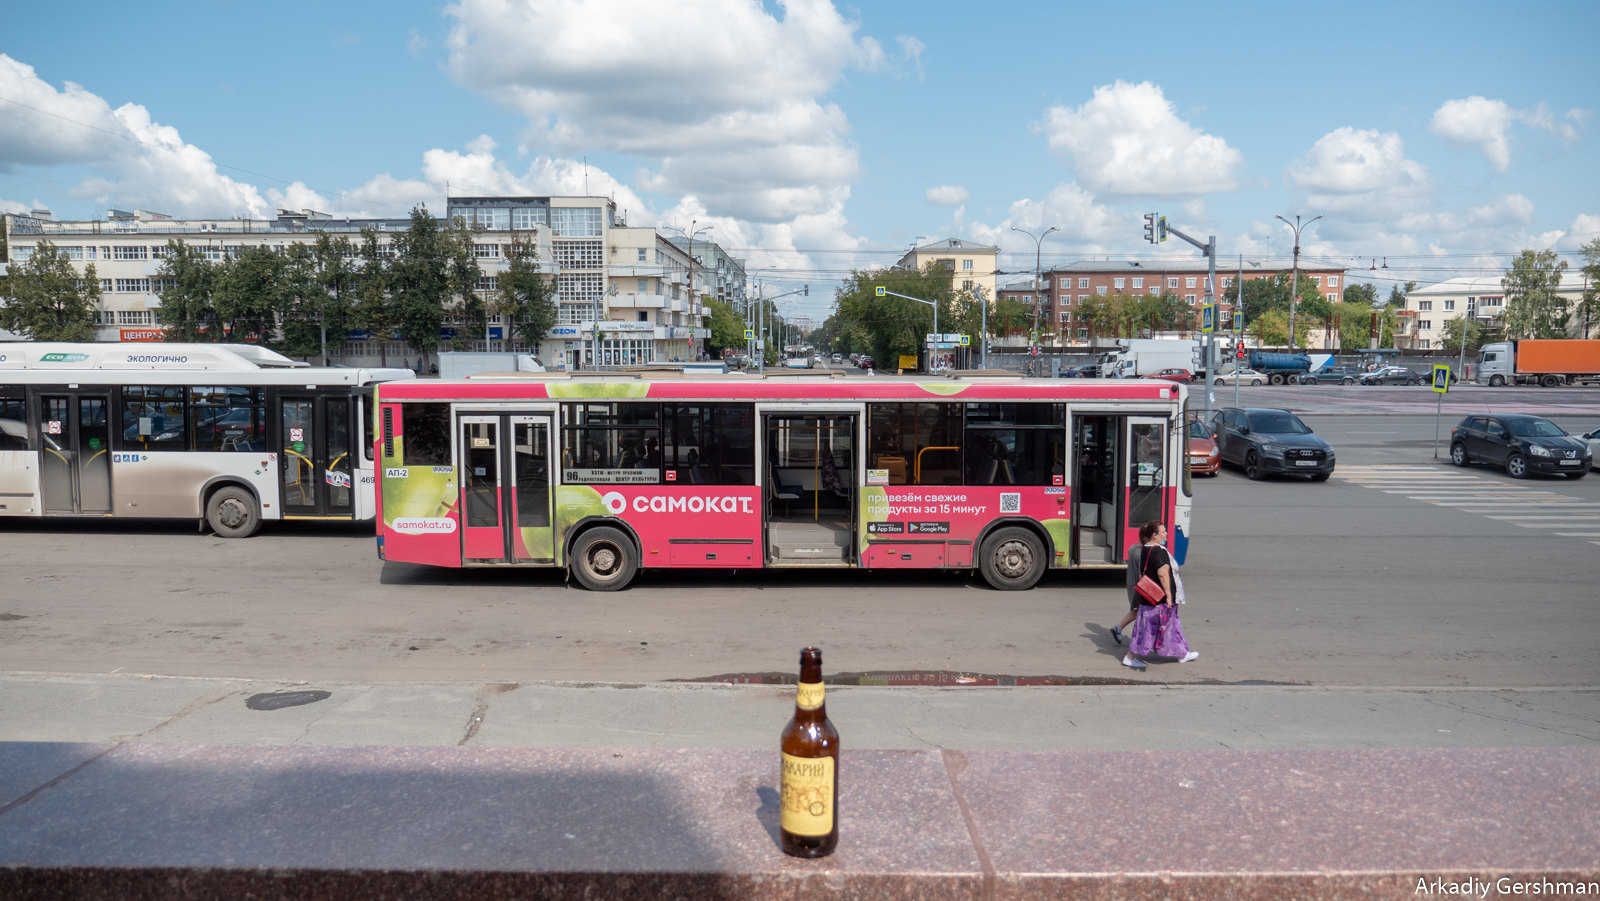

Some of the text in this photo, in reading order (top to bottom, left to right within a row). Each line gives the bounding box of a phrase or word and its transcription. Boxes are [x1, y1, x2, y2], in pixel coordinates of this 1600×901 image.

[127, 355, 187, 363] ЭКОЛОГИЧНО
[387, 469, 408, 477] АП-2
[566, 471, 579, 481] 96
[867, 492, 967, 504] привезём свежие
[867, 504, 987, 516] продукты за 15 минут
[397, 520, 452, 529] samokat.ru
